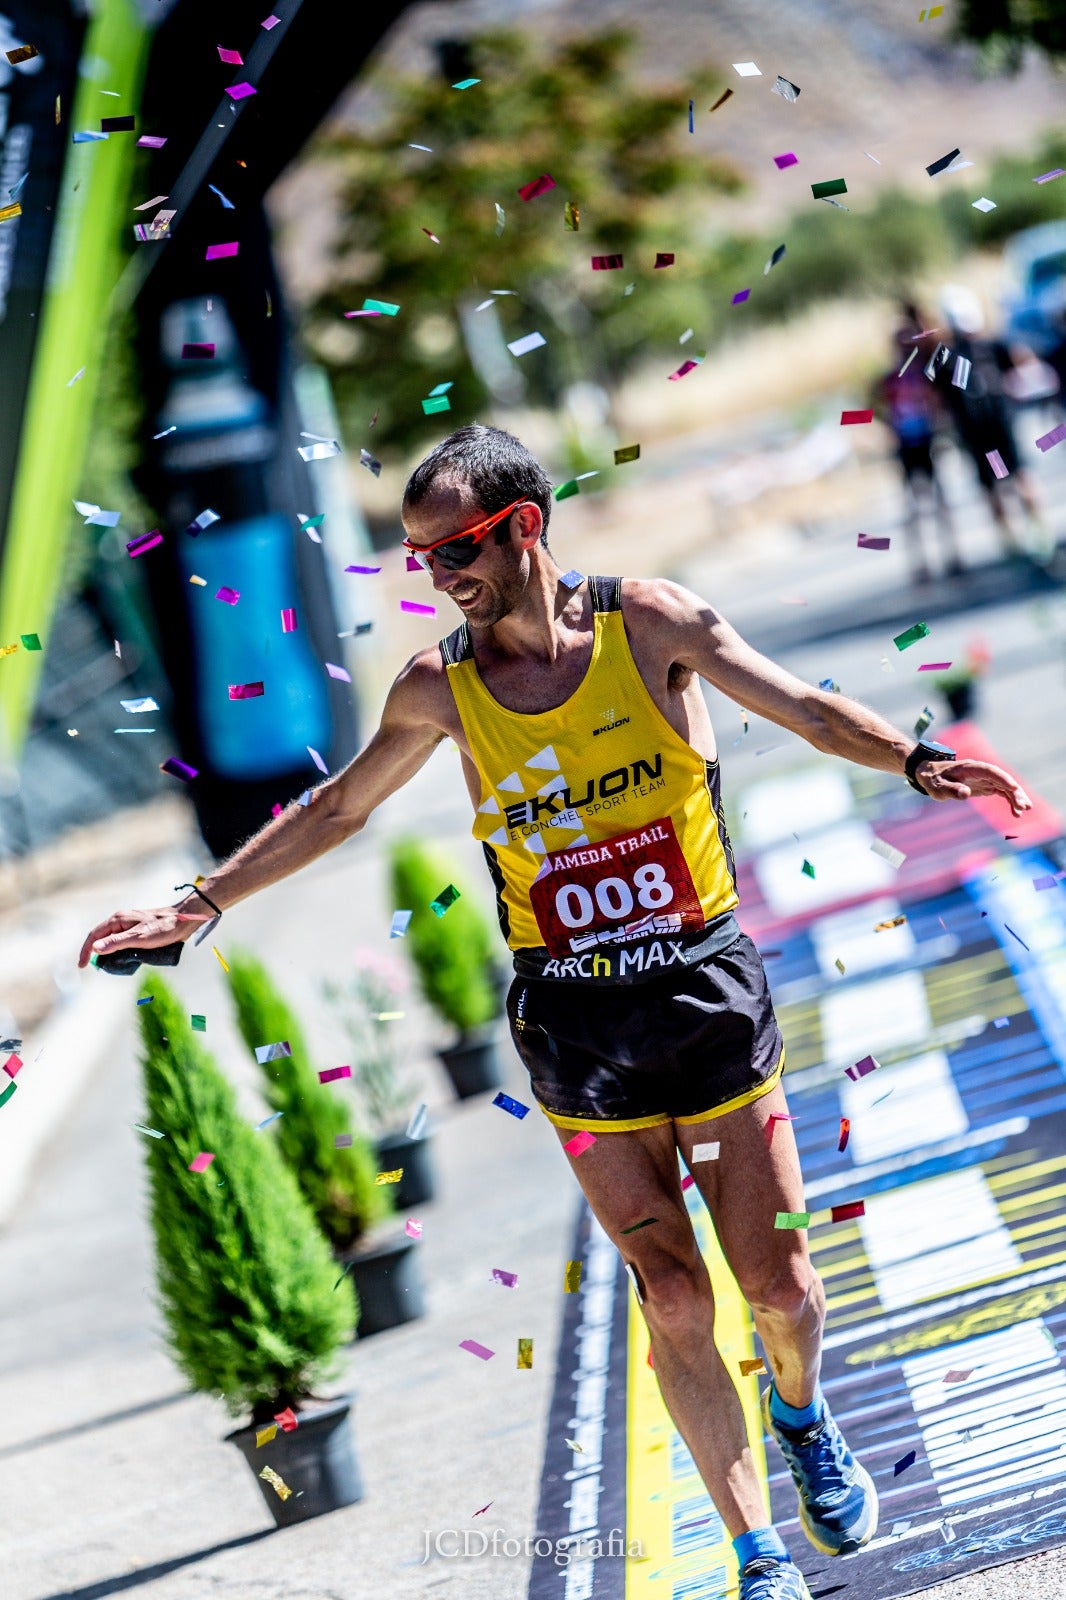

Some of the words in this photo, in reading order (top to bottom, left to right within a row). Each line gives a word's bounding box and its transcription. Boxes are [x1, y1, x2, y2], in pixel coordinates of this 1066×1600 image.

[592, 716, 631, 736] EKUON
[502, 753, 662, 830] EKUON
[521, 810, 583, 836] CONCHEL
[585, 796, 628, 817] SPORT
[632, 777, 667, 801] TEAM
[615, 825, 670, 856] TRAIL
[554, 863, 675, 930] 008
[619, 941, 688, 976] MAX
